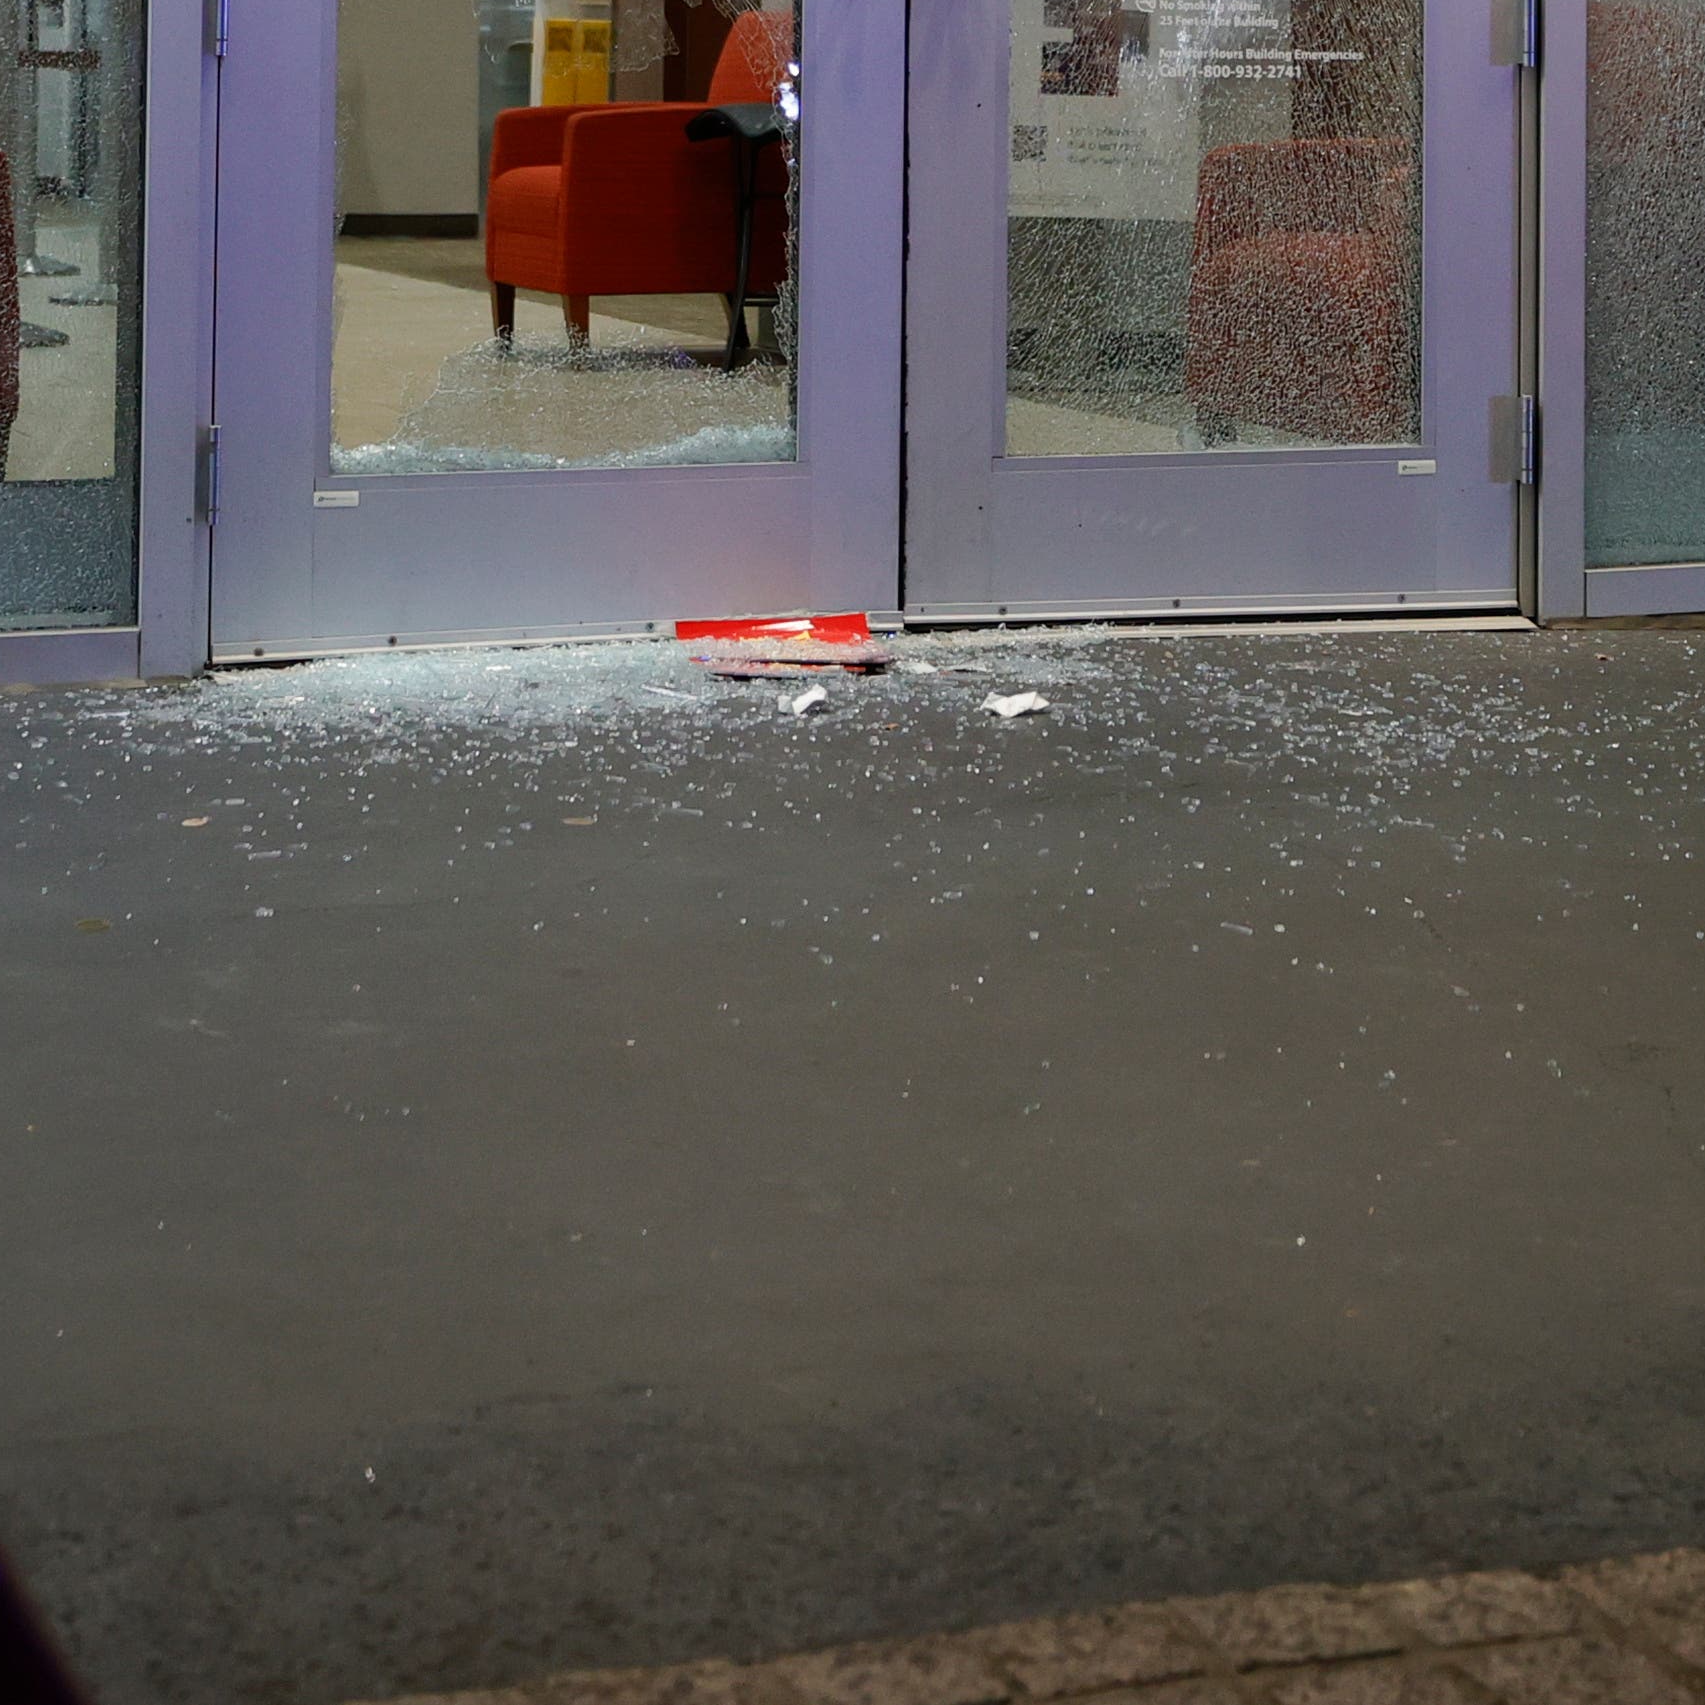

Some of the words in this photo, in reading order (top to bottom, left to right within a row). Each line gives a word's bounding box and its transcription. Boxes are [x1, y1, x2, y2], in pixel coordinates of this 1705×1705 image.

[1159, 0, 1175, 10] No
[1160, 16, 1173, 26] 25
[1210, 48, 1244, 60] Hours
[1245, 49, 1292, 62] Building
[1294, 49, 1364, 63] Emergencies
[1191, 65, 1302, 78] 1-800-932-2741
